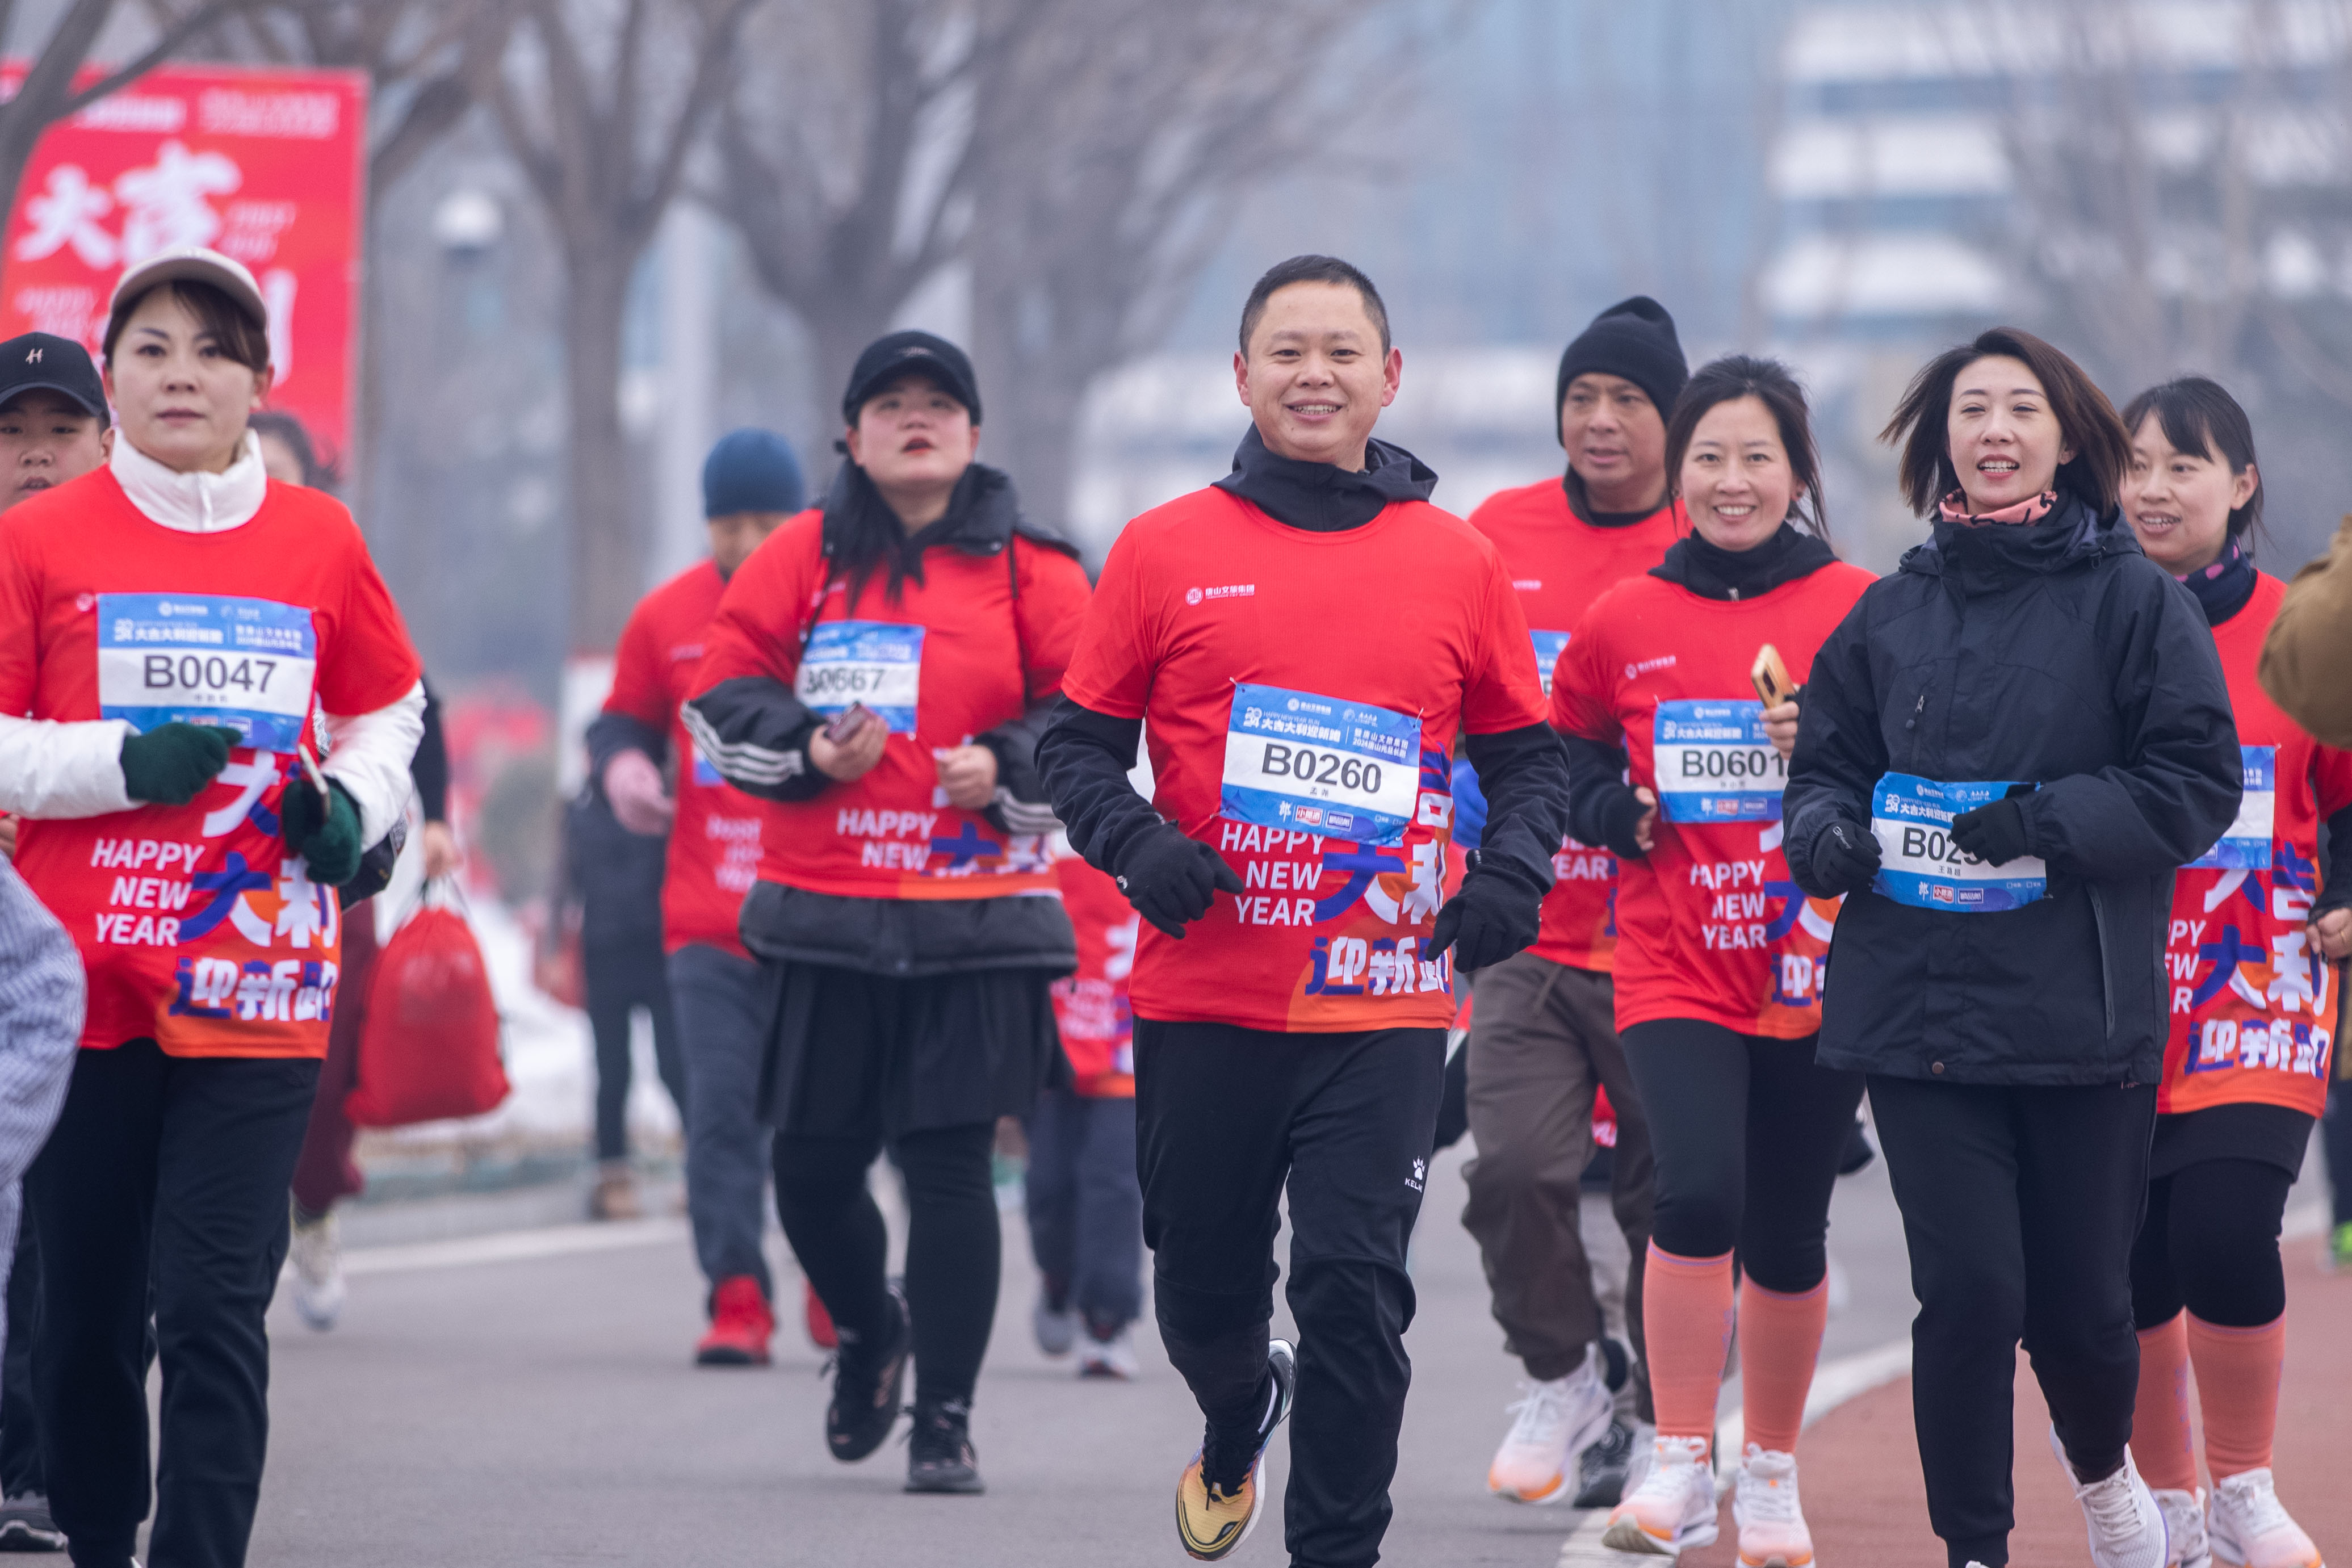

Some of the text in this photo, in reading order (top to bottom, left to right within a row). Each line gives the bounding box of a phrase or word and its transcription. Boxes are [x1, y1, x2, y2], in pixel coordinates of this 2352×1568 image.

[1205, 584, 1255, 596] 唐山文旅集团
[144, 655, 276, 694] B0047
[1261, 743, 1382, 794] B0260
[1682, 749, 1784, 777] B0601
[837, 808, 938, 840] HAPPY
[1221, 823, 1325, 856] HAPPY
[91, 838, 206, 874] HAPPY
[861, 841, 932, 871] NEW
[1902, 827, 1982, 866] B02
[1246, 860, 1323, 891] NEW
[1314, 839, 1446, 925] 大利
[1552, 854, 1609, 881] EAR
[1690, 860, 1766, 890] HAPPY
[110, 876, 191, 911] NEW
[178, 851, 339, 948] 大利
[1234, 895, 1316, 927] YEAR
[1712, 891, 1766, 921] NEW
[95, 912, 181, 947] YEAR
[1701, 924, 1767, 950] YEAR
[1305, 935, 1451, 997] 迎新跑
[2192, 924, 2329, 1016] 大利
[168, 957, 338, 1022] 迎新跑
[2184, 1018, 2331, 1079] 迎新跑
